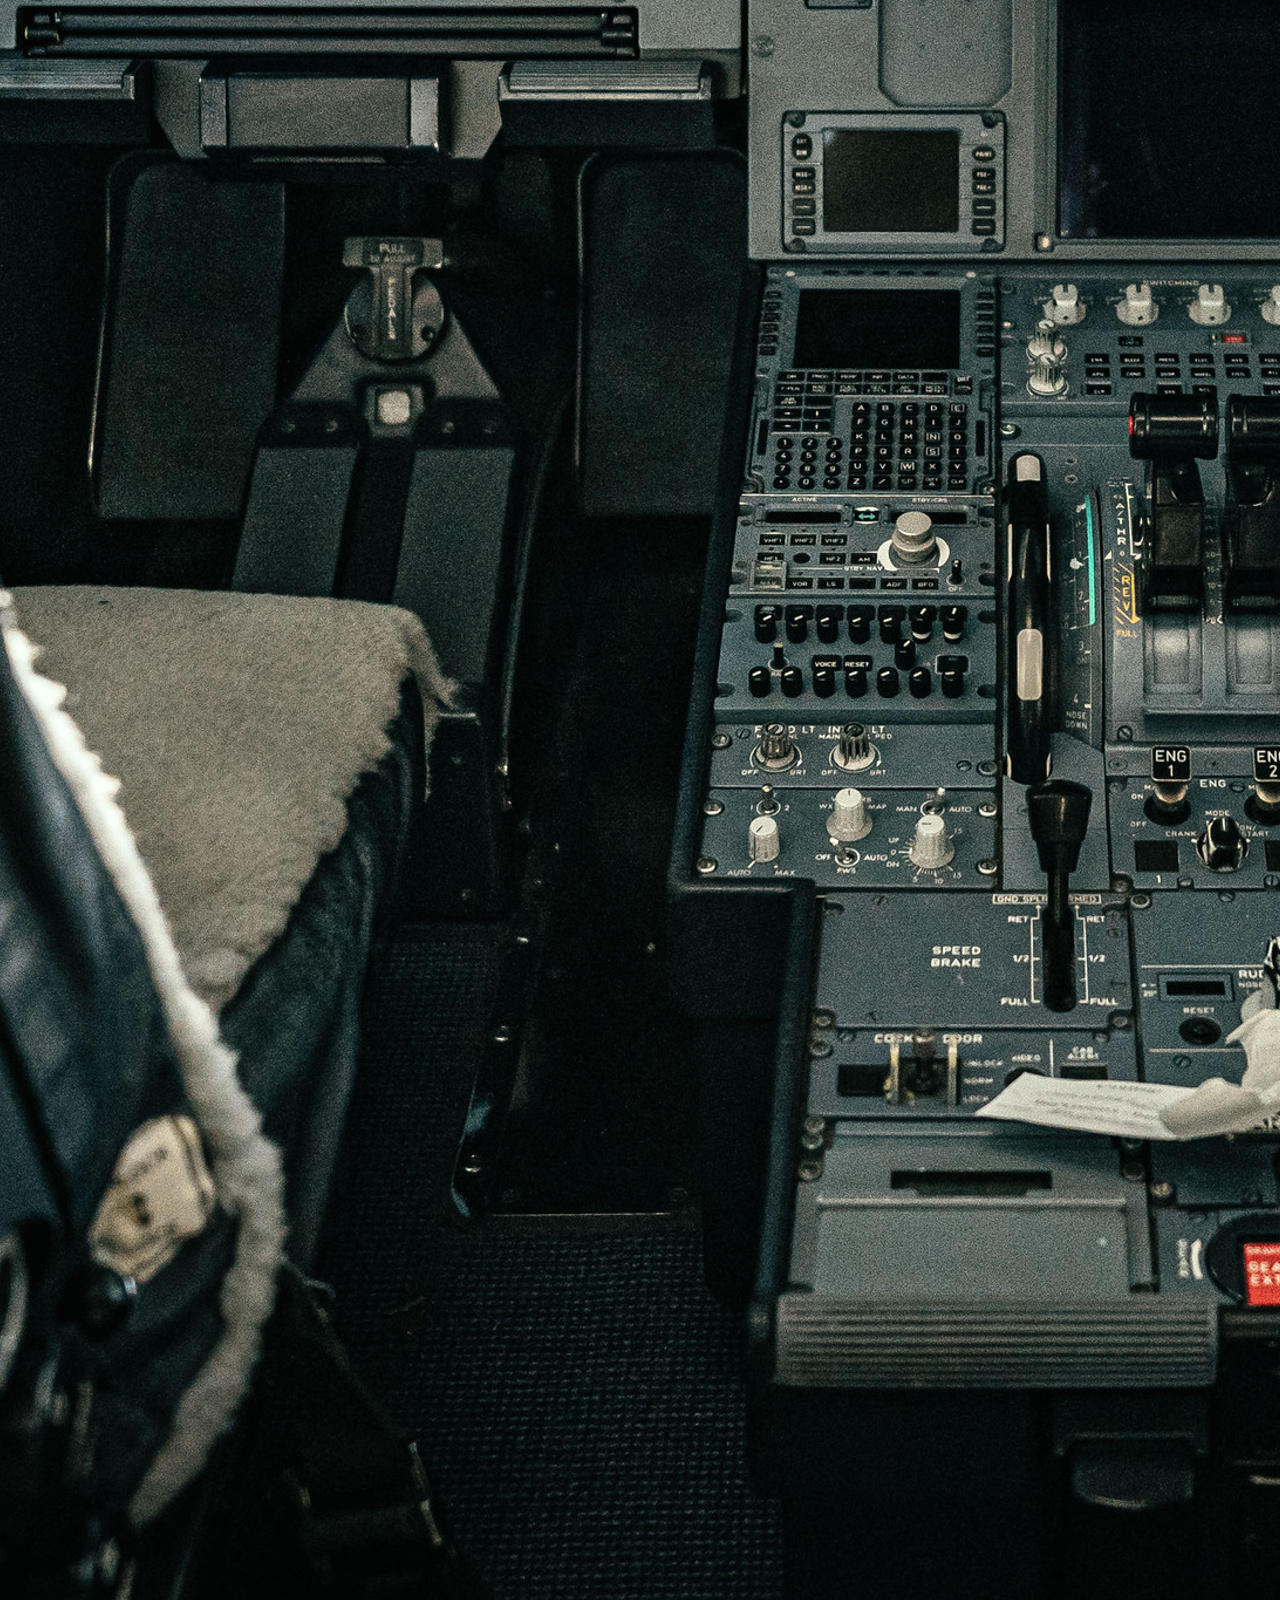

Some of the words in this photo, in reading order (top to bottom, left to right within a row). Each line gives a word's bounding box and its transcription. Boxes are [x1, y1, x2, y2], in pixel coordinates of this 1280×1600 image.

[1155, 750, 1187, 763] ENG
[1168, 765, 1174, 777] 1
[1270, 765, 1278, 778] 2
[1200, 779, 1226, 788] ENG
[1008, 915, 1028, 923] RET
[932, 946, 981, 955] SPEED
[931, 958, 981, 967] BRAKE
[1013, 955, 1030, 963] 1/2
[1089, 955, 1106, 963] 1/2
[1001, 997, 1028, 1006] FULL
[1090, 997, 1118, 1005] FULL
[942, 1034, 983, 1043] DOOR
